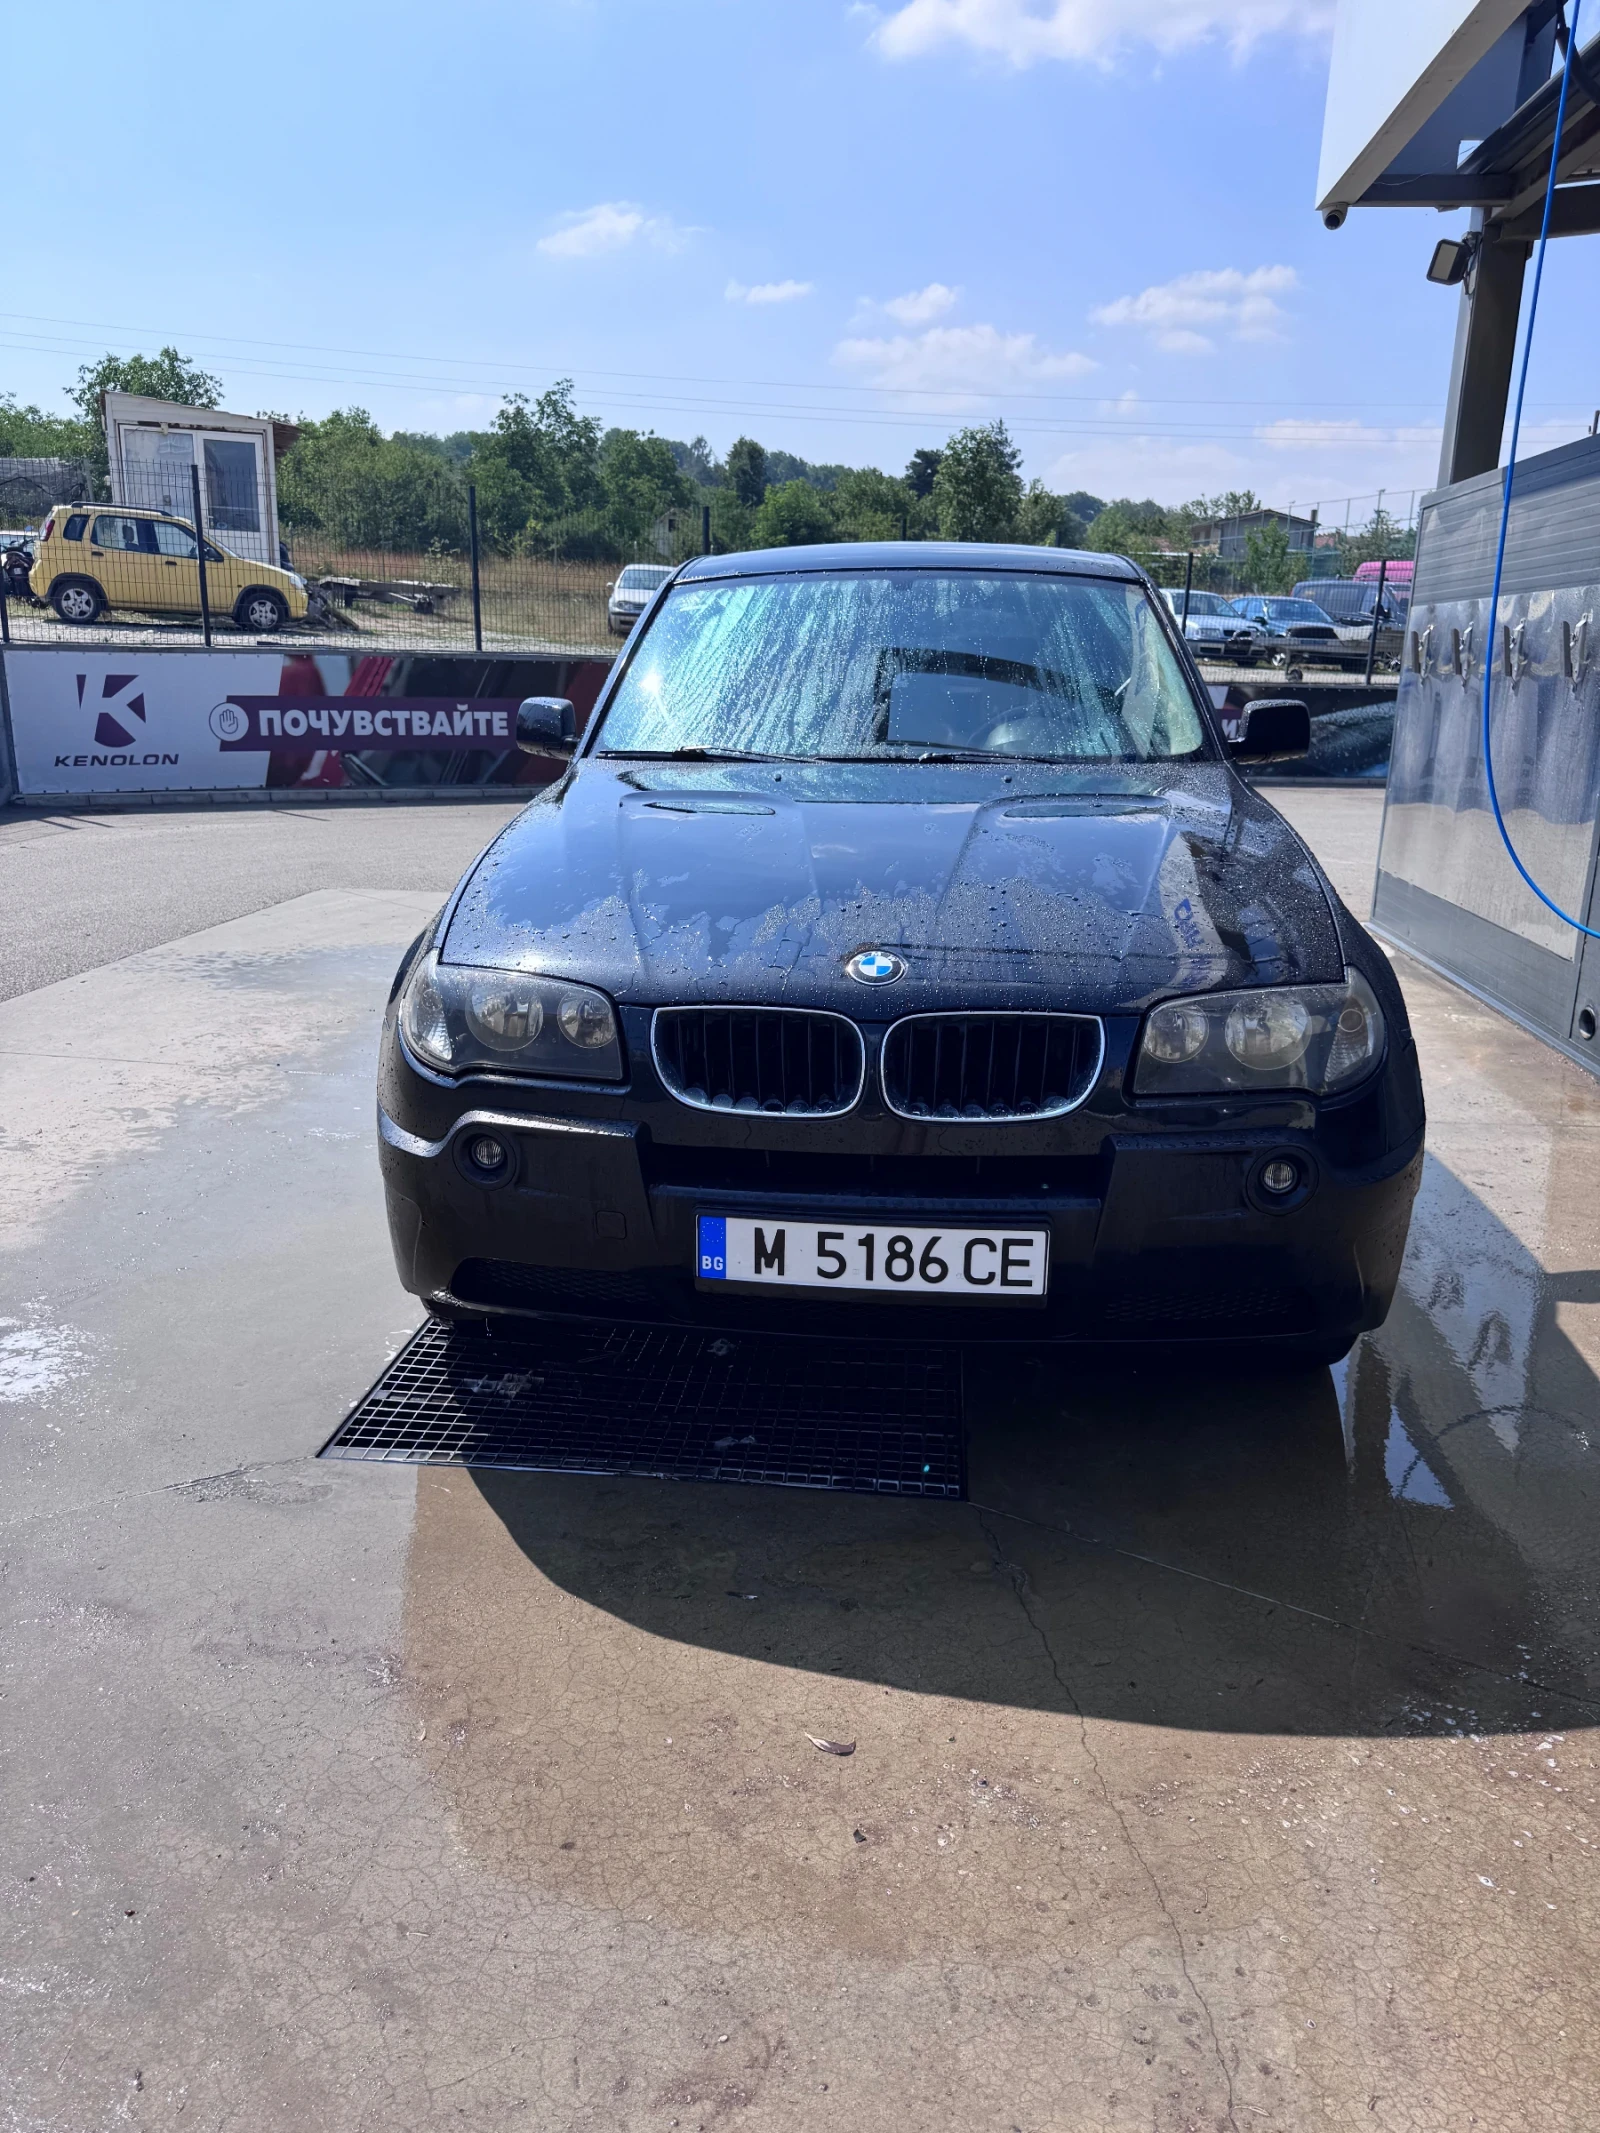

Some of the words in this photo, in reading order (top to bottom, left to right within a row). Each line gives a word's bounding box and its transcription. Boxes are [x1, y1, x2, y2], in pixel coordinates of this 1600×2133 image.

[259, 703, 509, 738] ПОЧУВСТВАЙТЕ
[54, 753, 179, 767] KENOLON
[701, 1256, 724, 1271] BG
[754, 1227, 786, 1276] M
[817, 1231, 949, 1284] 5186
[963, 1237, 1034, 1287] CE
